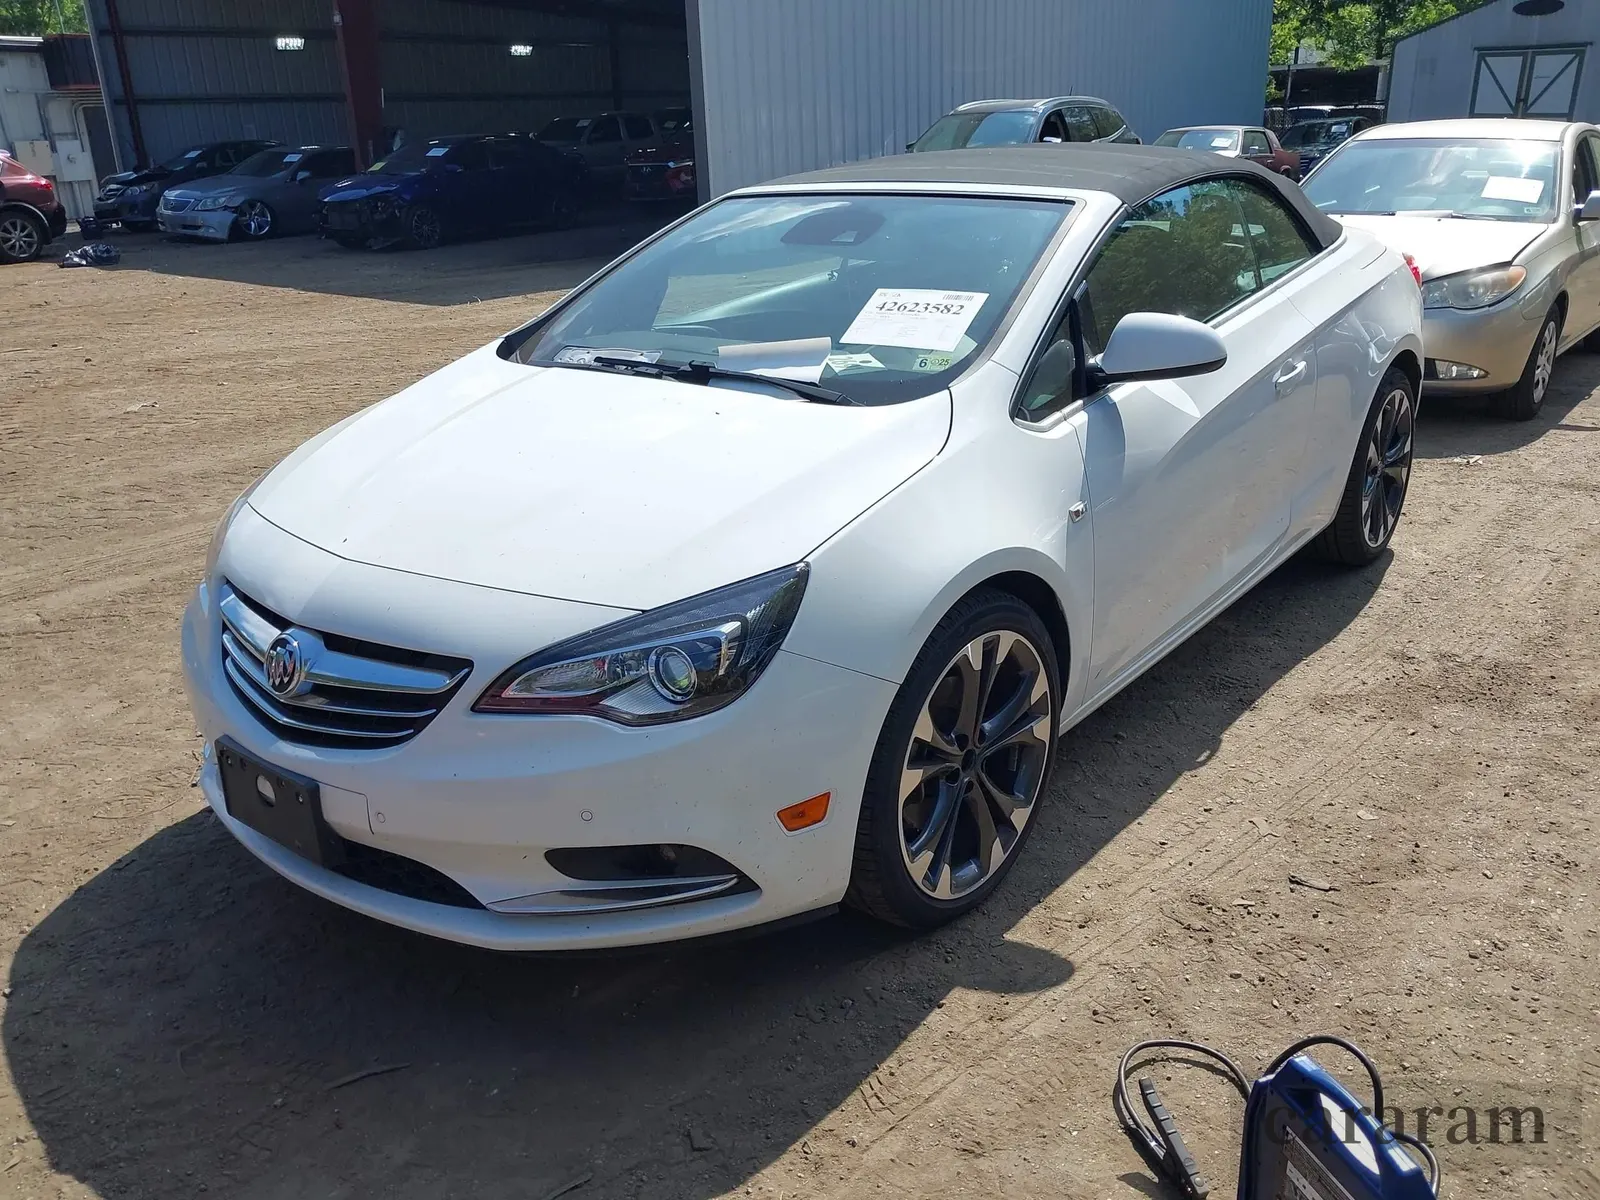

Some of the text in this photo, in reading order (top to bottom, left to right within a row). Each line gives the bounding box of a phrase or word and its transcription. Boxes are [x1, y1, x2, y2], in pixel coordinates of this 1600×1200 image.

[875, 301, 965, 316] 42623582
[919, 358, 949, 368] 6 25
